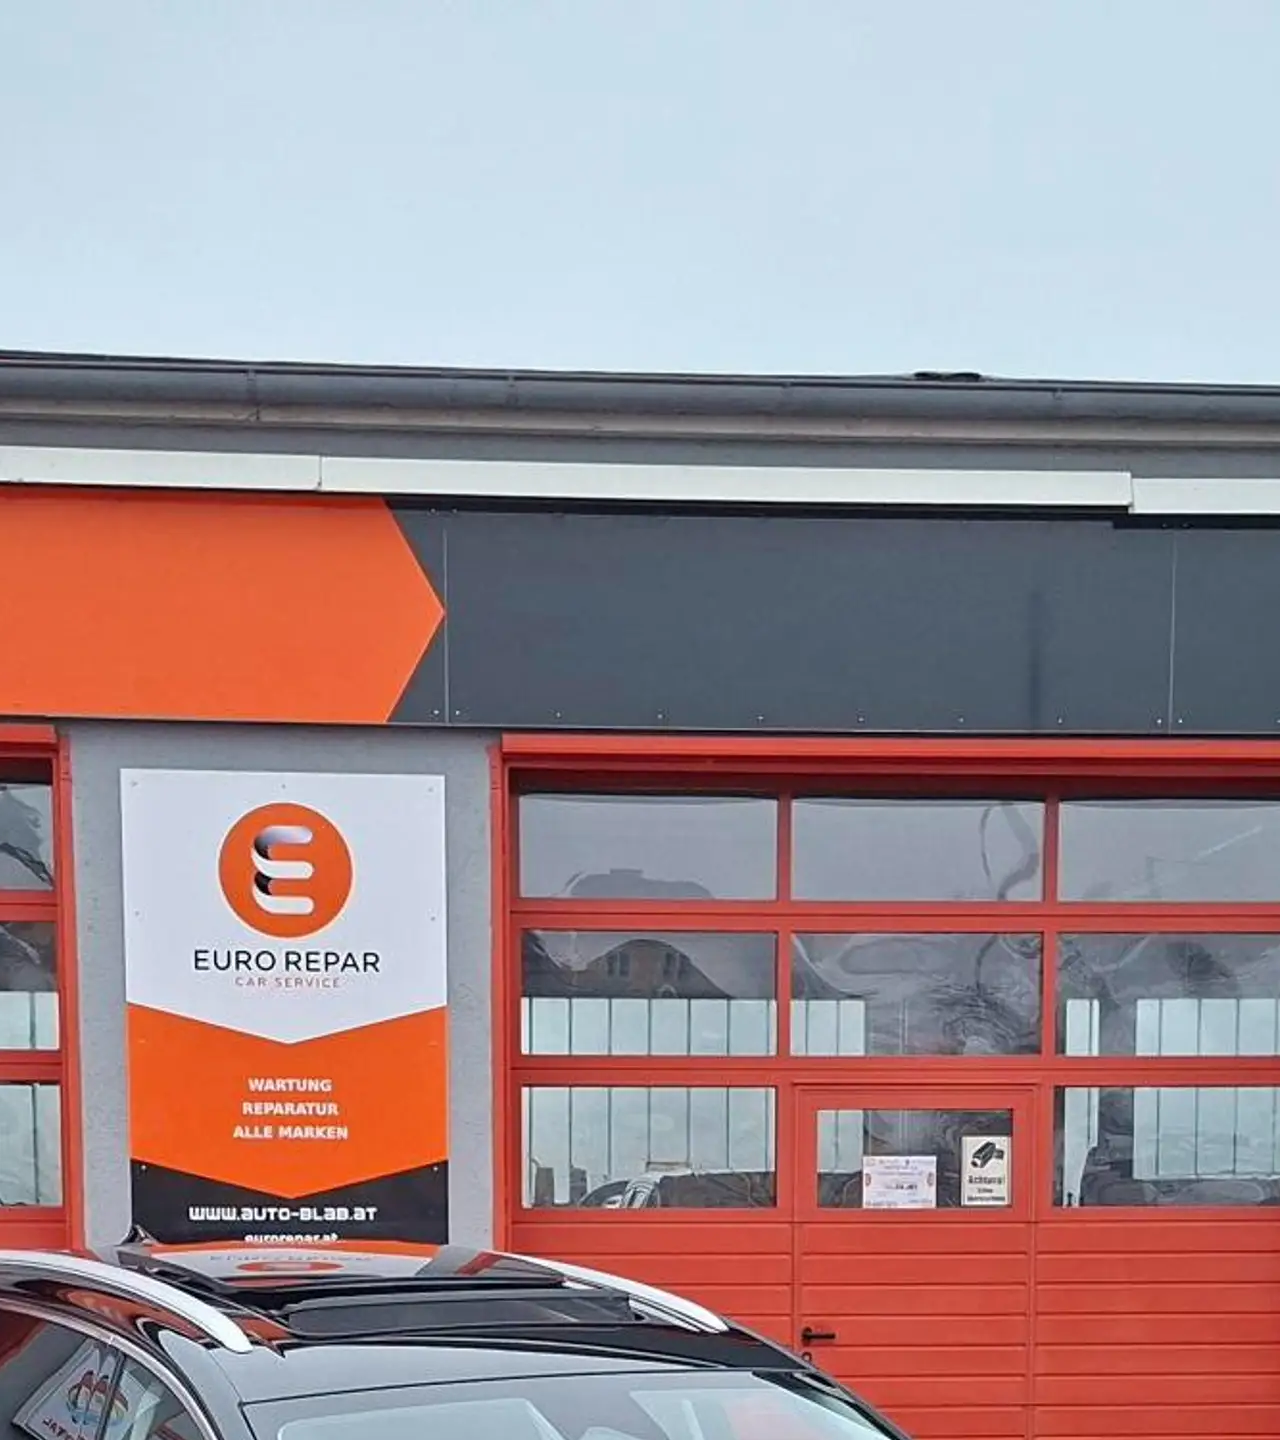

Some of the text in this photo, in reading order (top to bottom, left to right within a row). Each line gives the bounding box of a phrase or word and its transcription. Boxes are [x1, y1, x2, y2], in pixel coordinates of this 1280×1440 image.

[194, 950, 380, 973] EURO REPAR
[235, 977, 341, 989] CAR SERVICE
[248, 1078, 332, 1092] WARTUNG
[242, 1102, 339, 1115] REPARATUR
[233, 1125, 348, 1139] ALLE MARKEN
